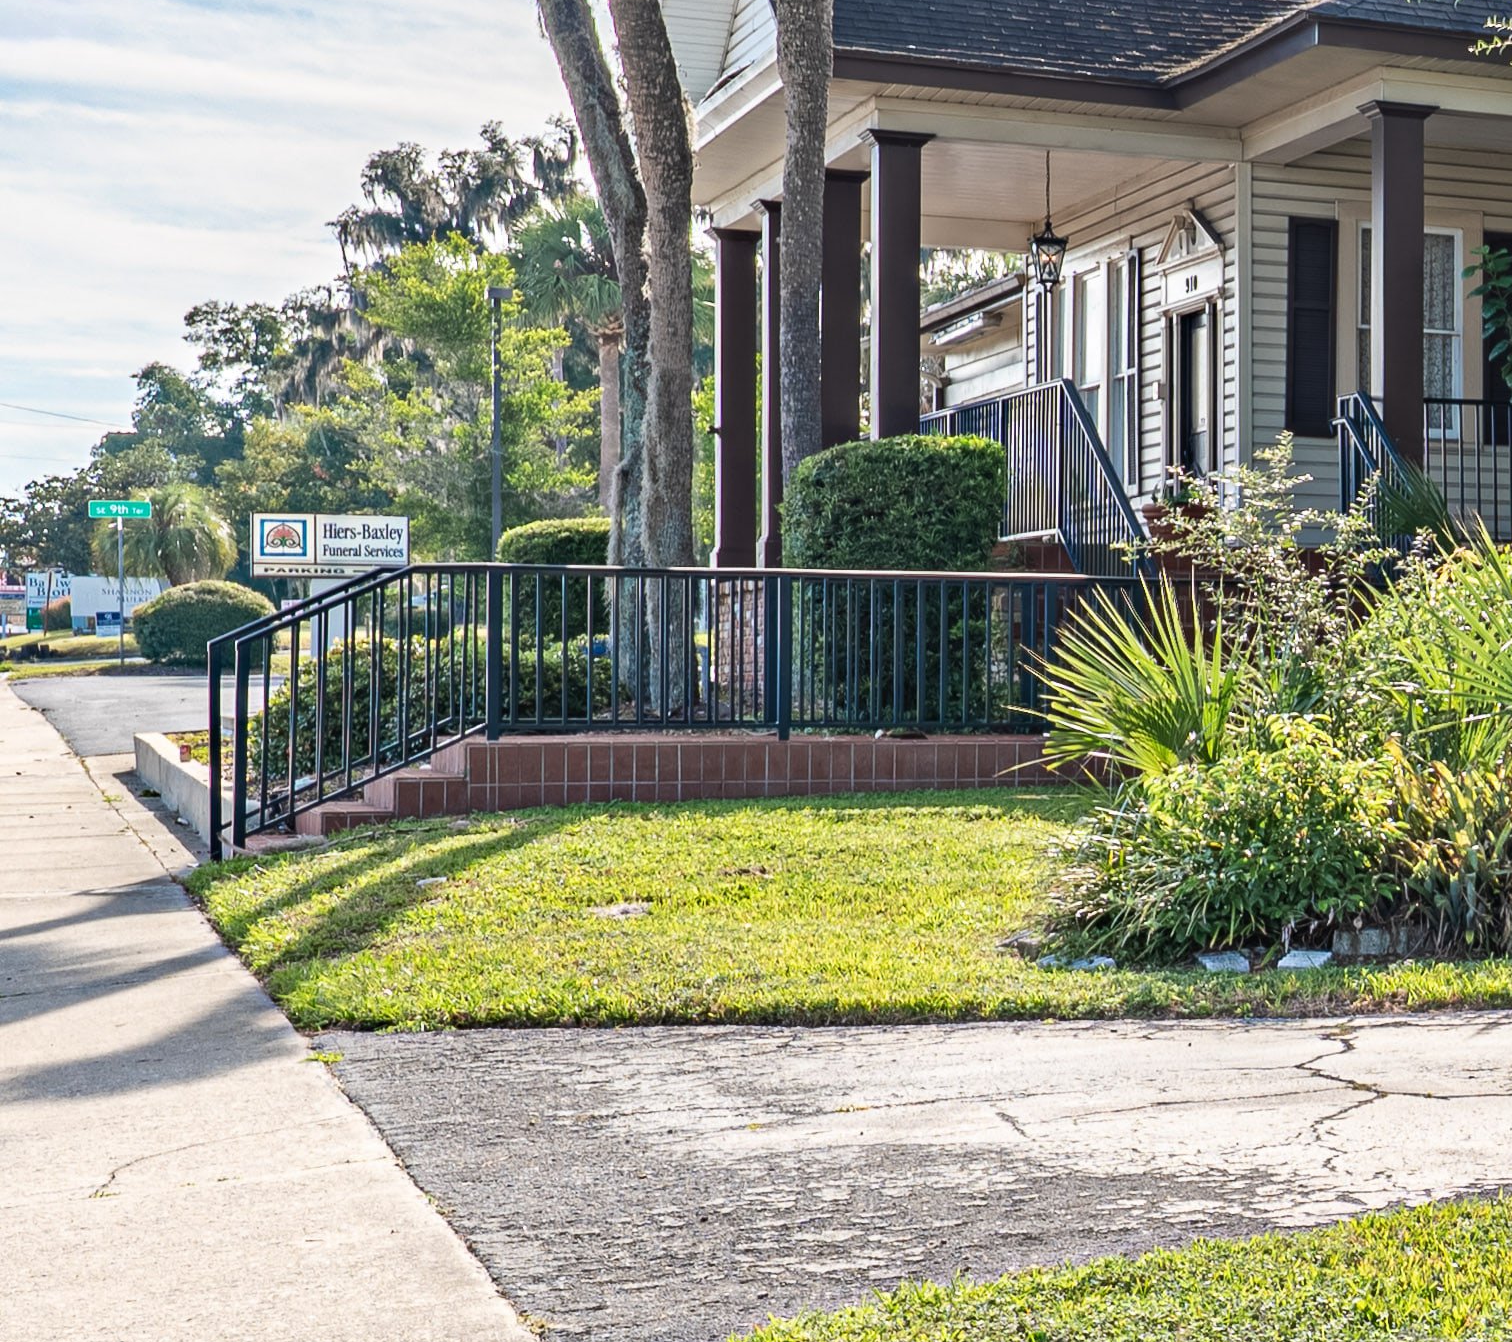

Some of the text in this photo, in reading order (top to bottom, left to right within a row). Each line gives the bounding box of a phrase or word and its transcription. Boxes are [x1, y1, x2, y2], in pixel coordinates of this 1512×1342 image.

[1185, 274, 1198, 294] 910
[109, 504, 129, 515] 9th
[132, 507, 144, 515] Ter
[322, 523, 403, 545] Hiers-Baxley
[322, 544, 404, 558] Funeral Services
